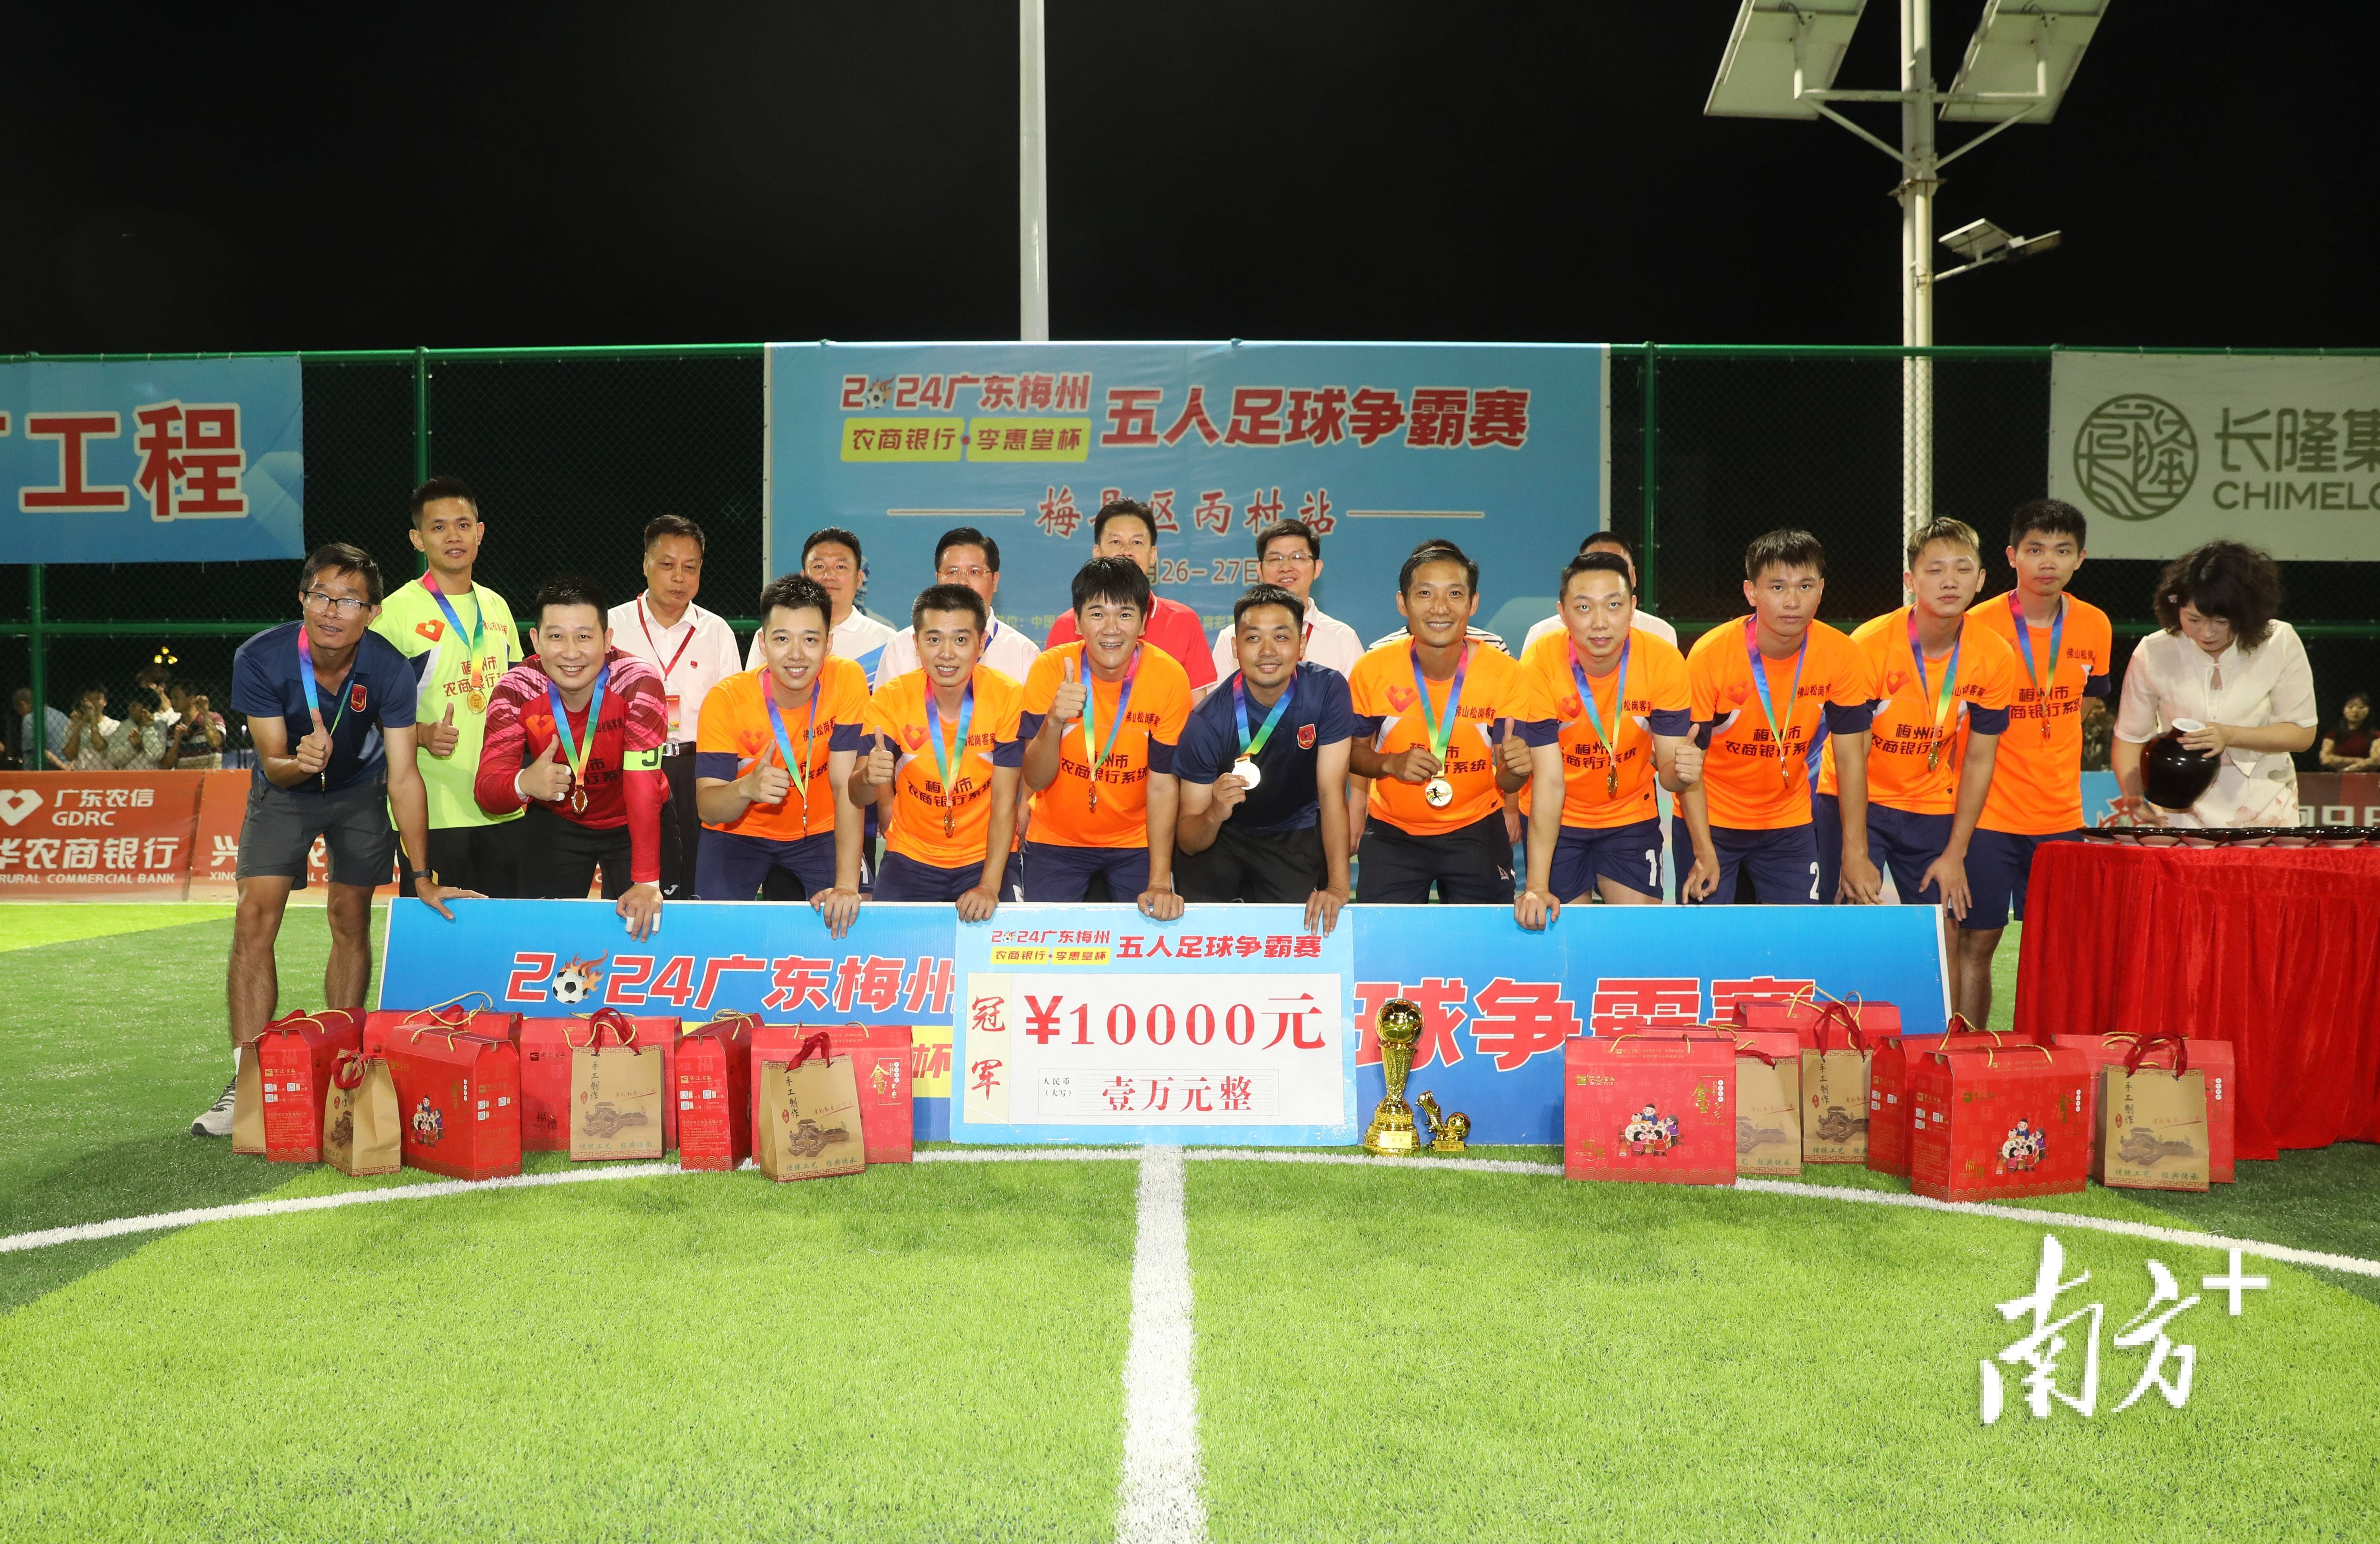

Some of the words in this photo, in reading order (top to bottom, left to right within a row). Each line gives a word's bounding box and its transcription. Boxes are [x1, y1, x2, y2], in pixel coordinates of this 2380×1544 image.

[1101, 384, 1531, 450] 五人足球争霸赛
[0, 400, 247, 522] 工程
[53, 788, 155, 808] 广东农信
[52, 811, 116, 827] GDRC
[46, 873, 133, 885] COMMERCIAL
[138, 873, 175, 884] BANK
[1116, 934, 1322, 959] 五人足球争霸赛
[590, 1061, 599, 1101] 手工制作
[786, 1076, 800, 1119] 手工制作
[1043, 1077, 1070, 1085] 人民币
[1102, 1075, 1253, 1112] 壹万元整
[1819, 1064, 1829, 1105] 手工制作
[2124, 1081, 2134, 1125] 手工制作
[786, 1161, 818, 1172] 传统工艺
[825, 1156, 858, 1167] 经典传承
